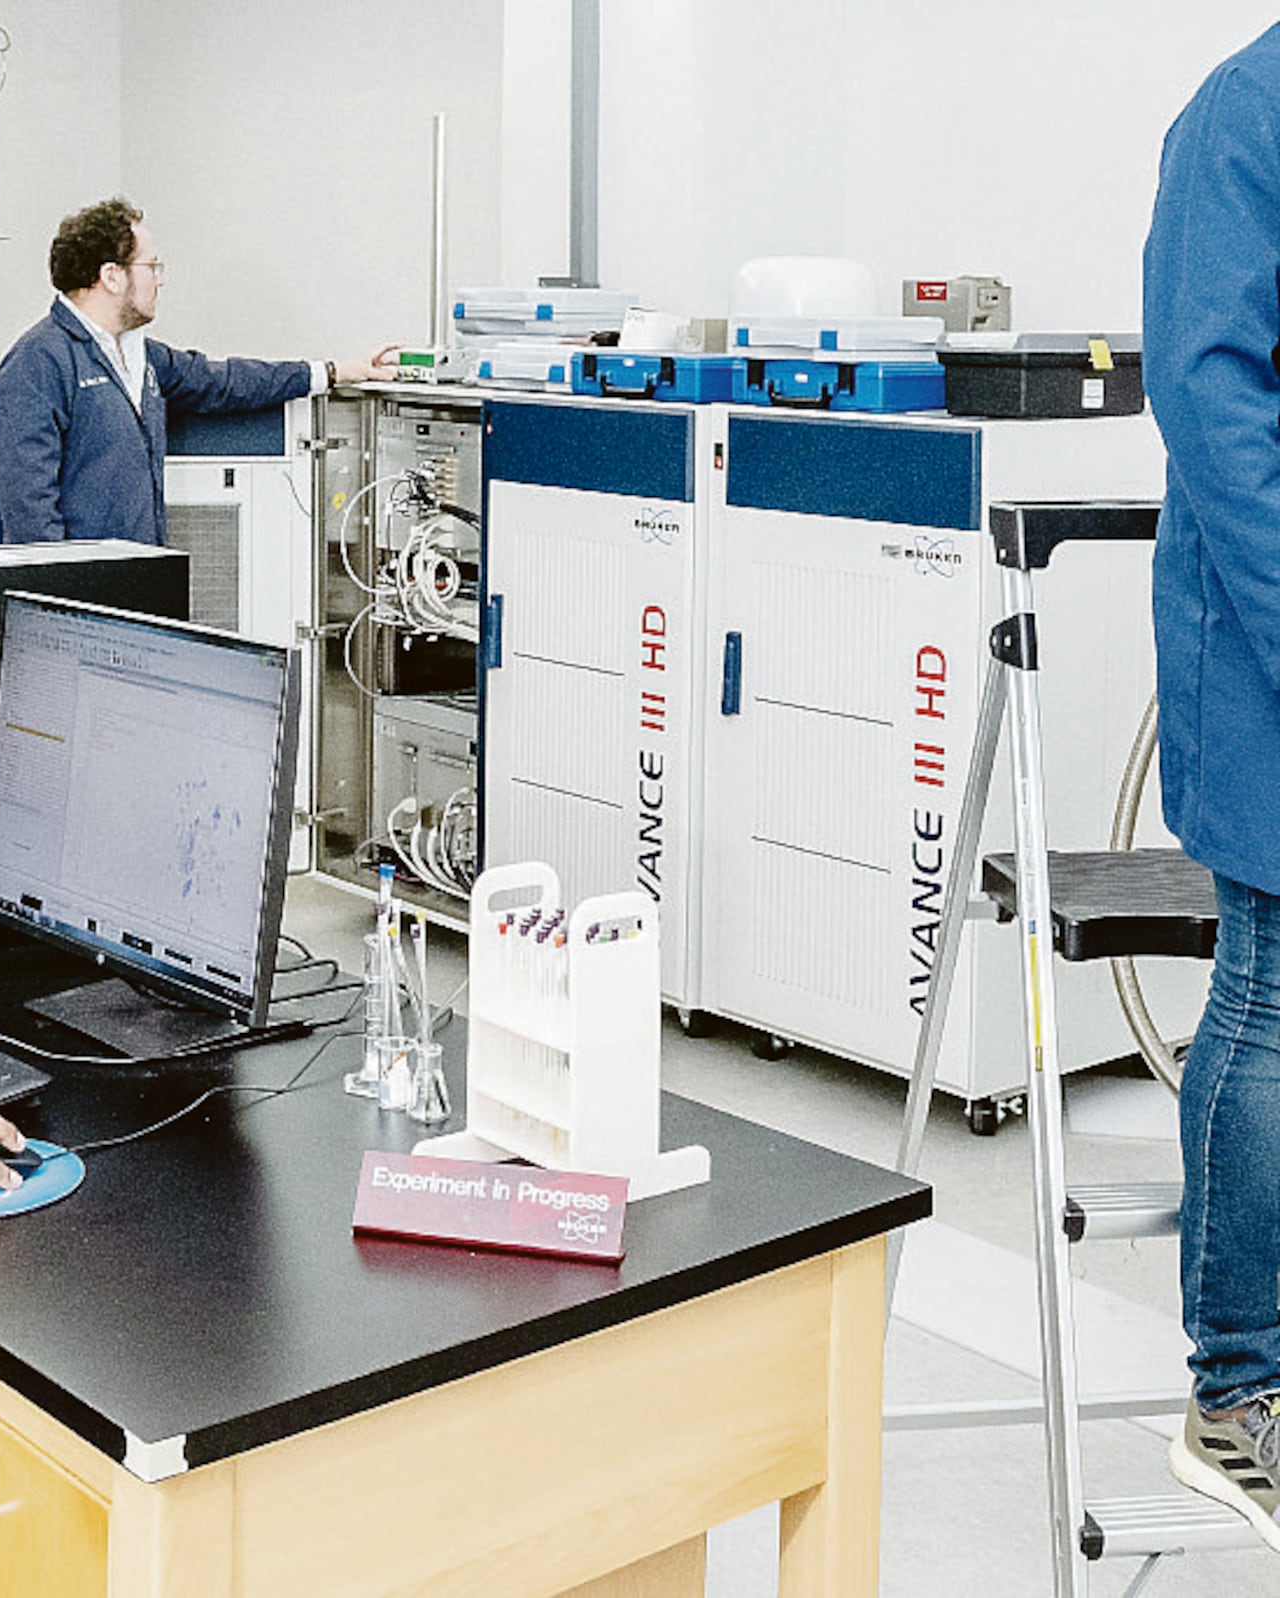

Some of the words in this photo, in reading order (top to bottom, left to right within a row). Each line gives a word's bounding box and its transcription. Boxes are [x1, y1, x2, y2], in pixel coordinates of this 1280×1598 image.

[641, 605, 666, 671] HD
[915, 645, 947, 719] HD
[640, 692, 665, 732] III
[913, 742, 945, 788] III
[637, 750, 663, 902] VANCE
[372, 1166, 487, 1198] Experiment
[517, 1181, 610, 1212] Progress
